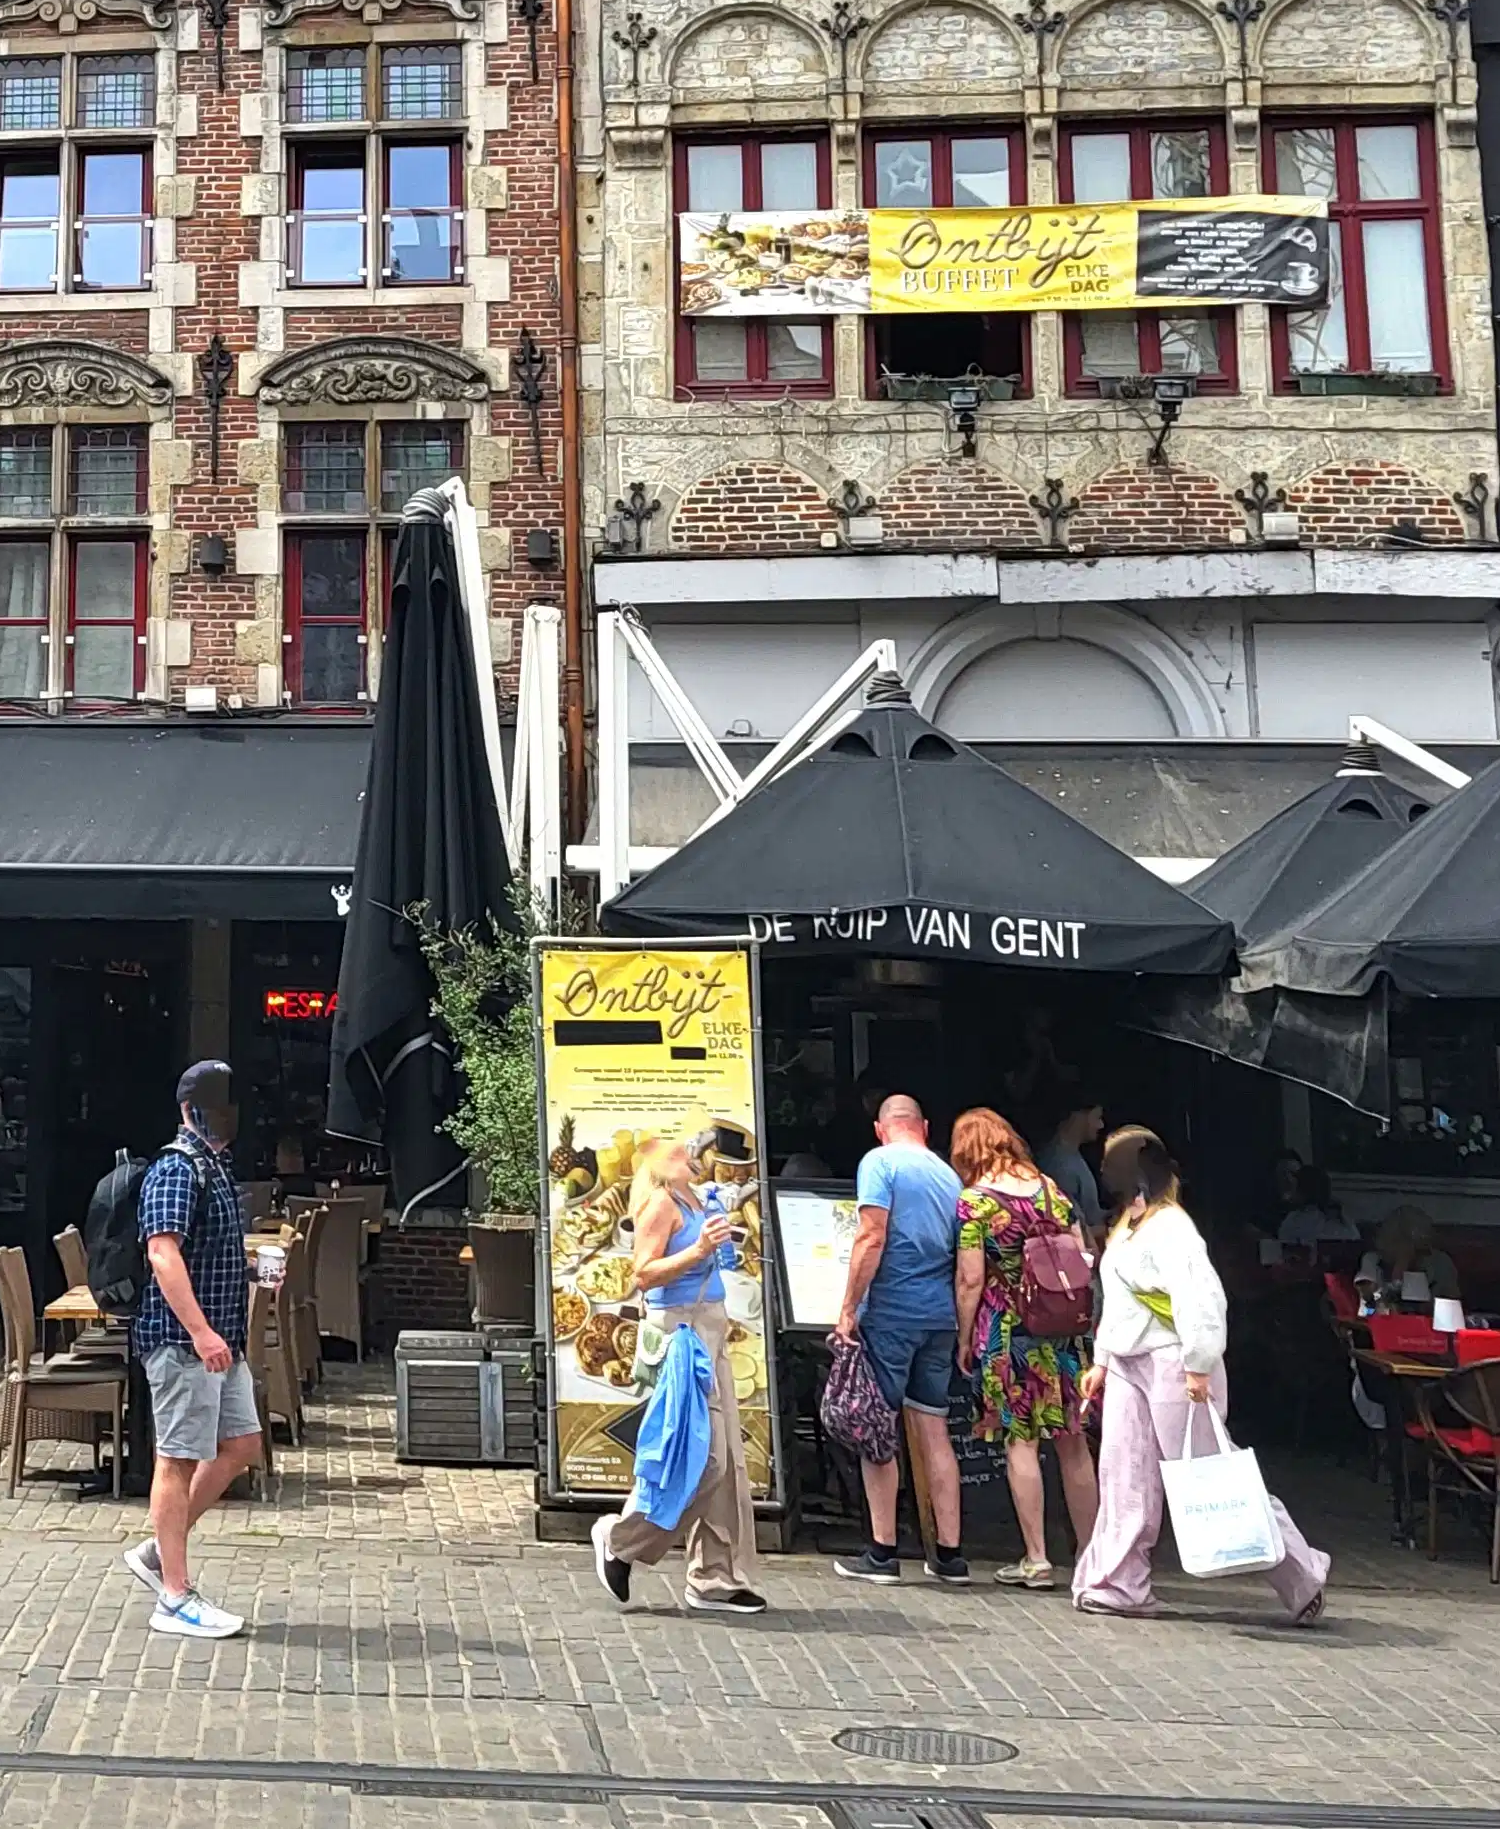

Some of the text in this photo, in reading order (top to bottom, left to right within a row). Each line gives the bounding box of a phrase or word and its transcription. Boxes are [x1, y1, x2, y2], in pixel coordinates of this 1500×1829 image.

[1066, 264, 1109, 278] ELKE
[900, 268, 1019, 293] BUFFET
[1070, 278, 1110, 293] DAG
[749, 913, 796, 944] DE
[905, 906, 971, 949] VAN
[991, 915, 1086, 959] GENT
[702, 1021, 743, 1035] ELKE
[707, 1036, 743, 1050] DAG
